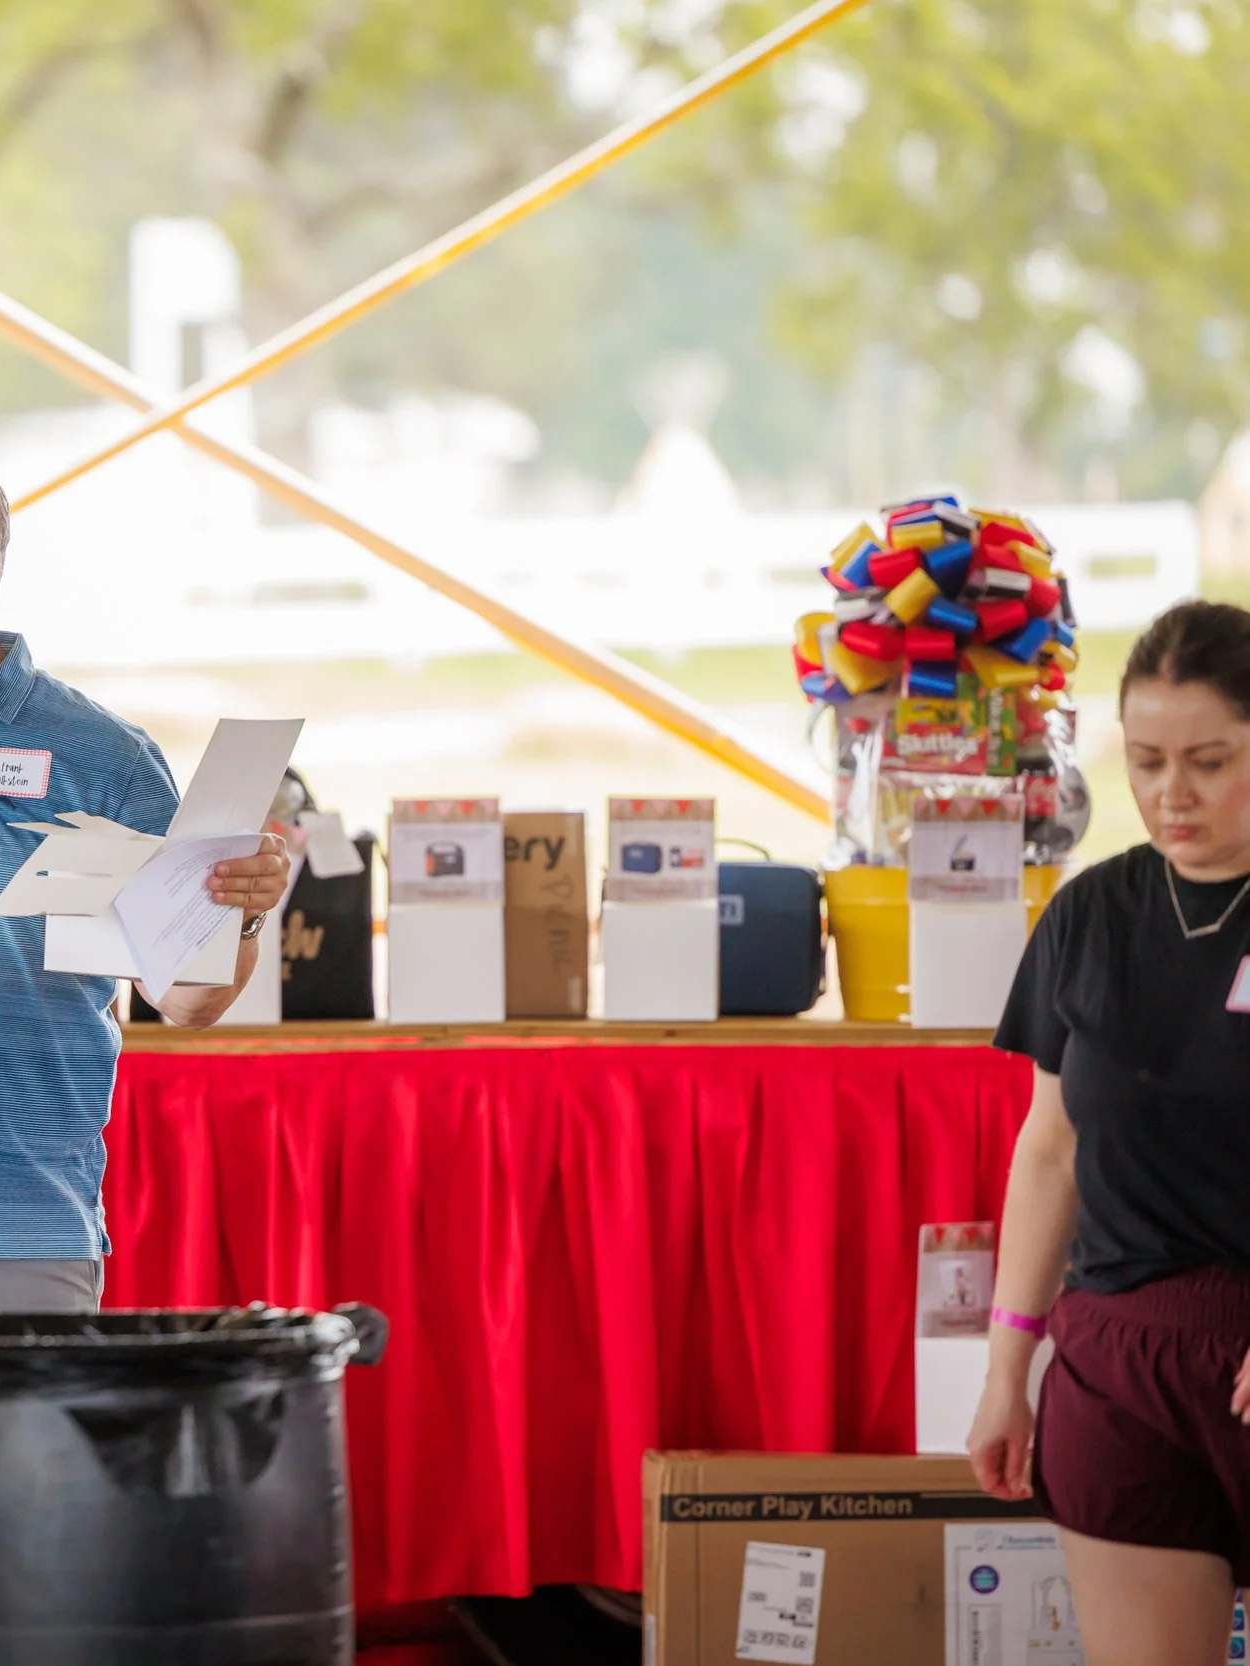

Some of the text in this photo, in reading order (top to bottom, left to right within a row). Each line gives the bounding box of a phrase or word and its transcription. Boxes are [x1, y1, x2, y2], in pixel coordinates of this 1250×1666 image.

[672, 1493, 913, 1520] Corner Play Kitchen
